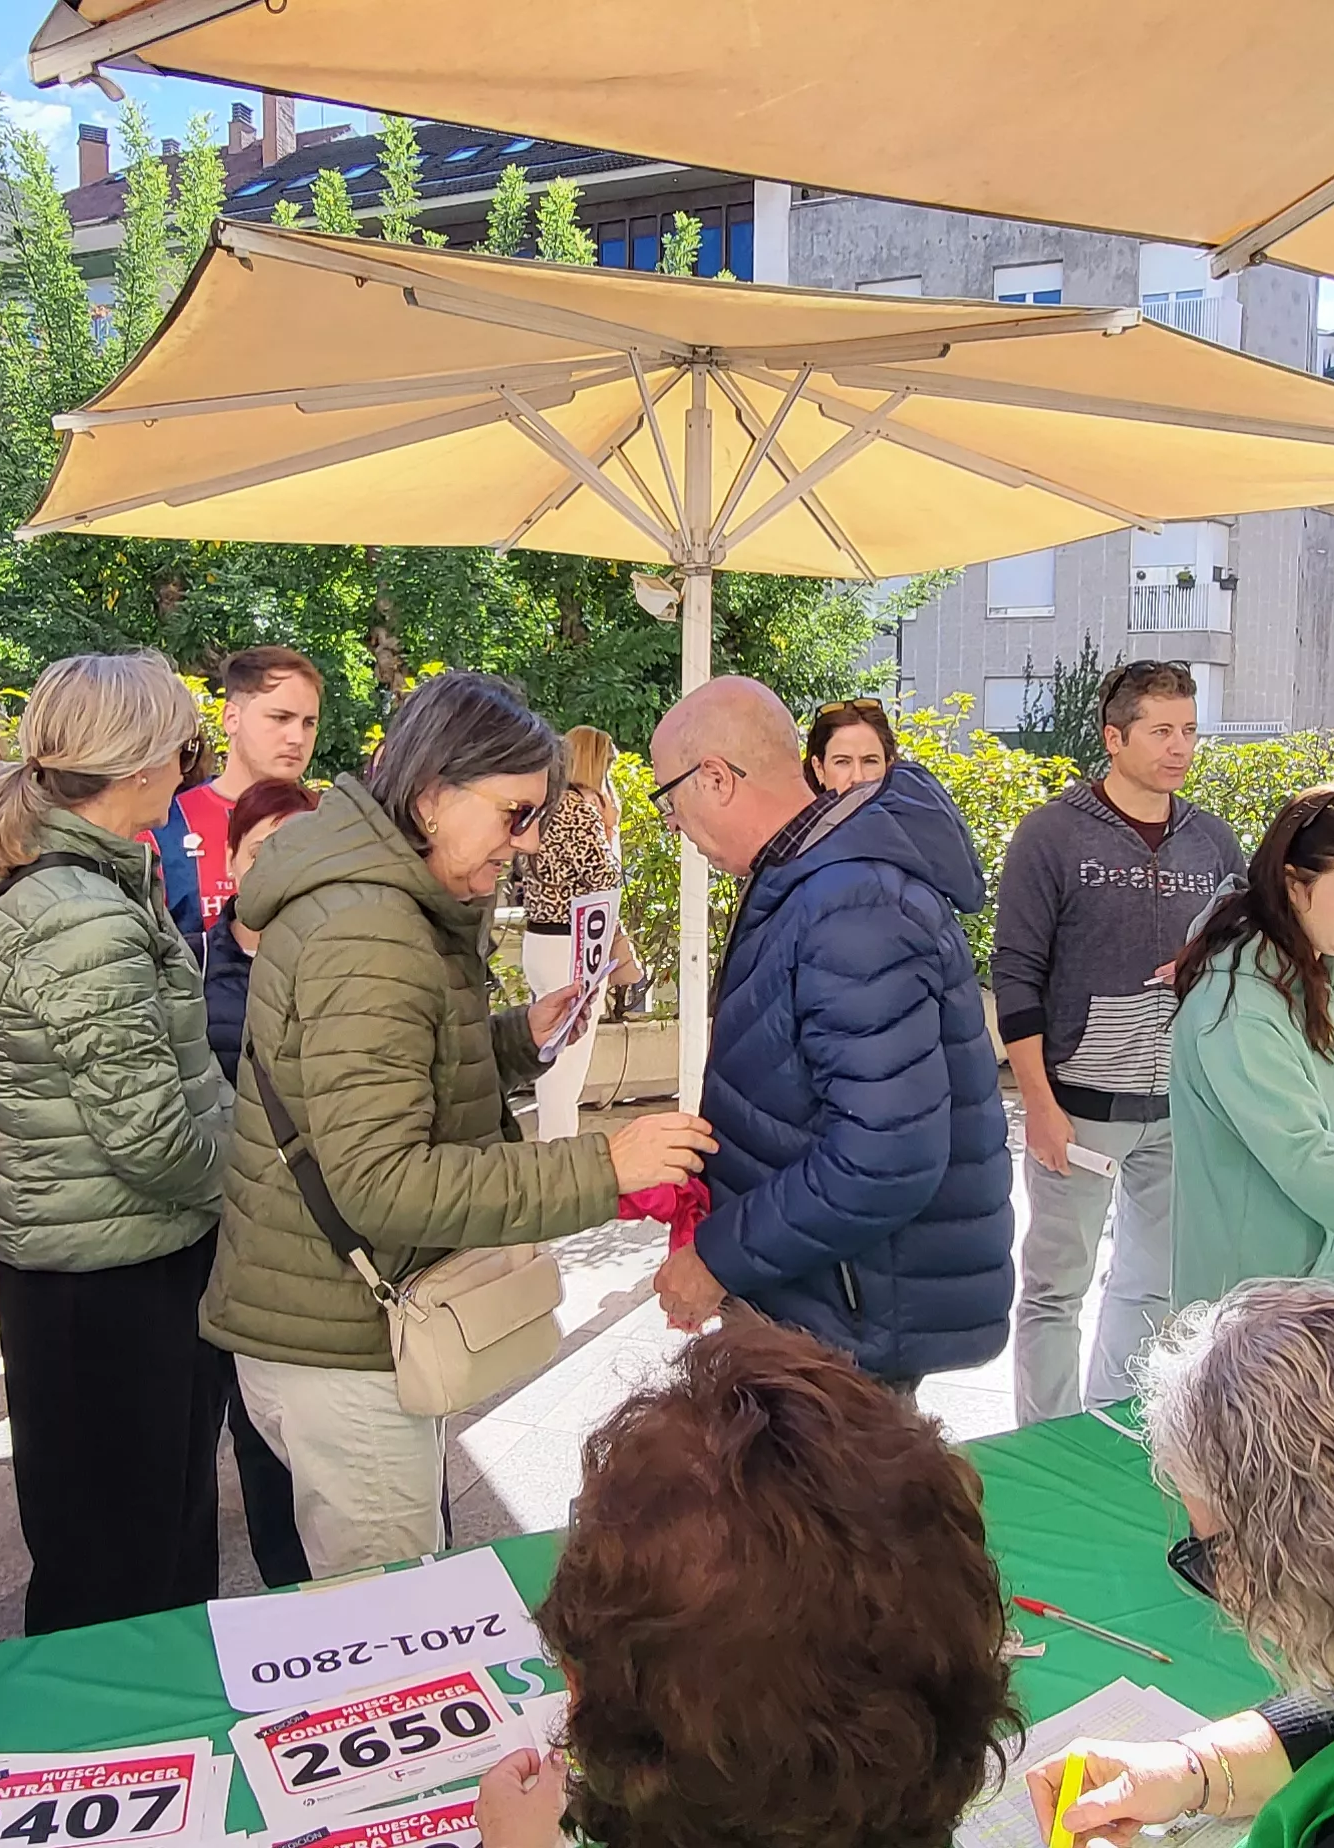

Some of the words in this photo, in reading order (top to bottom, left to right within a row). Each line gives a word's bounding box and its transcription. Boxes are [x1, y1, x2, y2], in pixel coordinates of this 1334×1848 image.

[216, 881, 233, 890] TU
[251, 1613, 507, 1684] 2401-2800
[277, 1712, 364, 1744] CONTRA
[368, 1705, 390, 1722] EL
[392, 1684, 470, 1713] CÁNCER
[342, 1694, 401, 1717] HUESCA
[281, 1701, 492, 1787] 2650
[41, 1765, 107, 1782] HUESCA
[60, 1776, 86, 1792] EL
[91, 1766, 181, 1788] CÁNCER
[365, 1814, 433, 1837] HUESCA
[391, 1830, 418, 1845] EL
